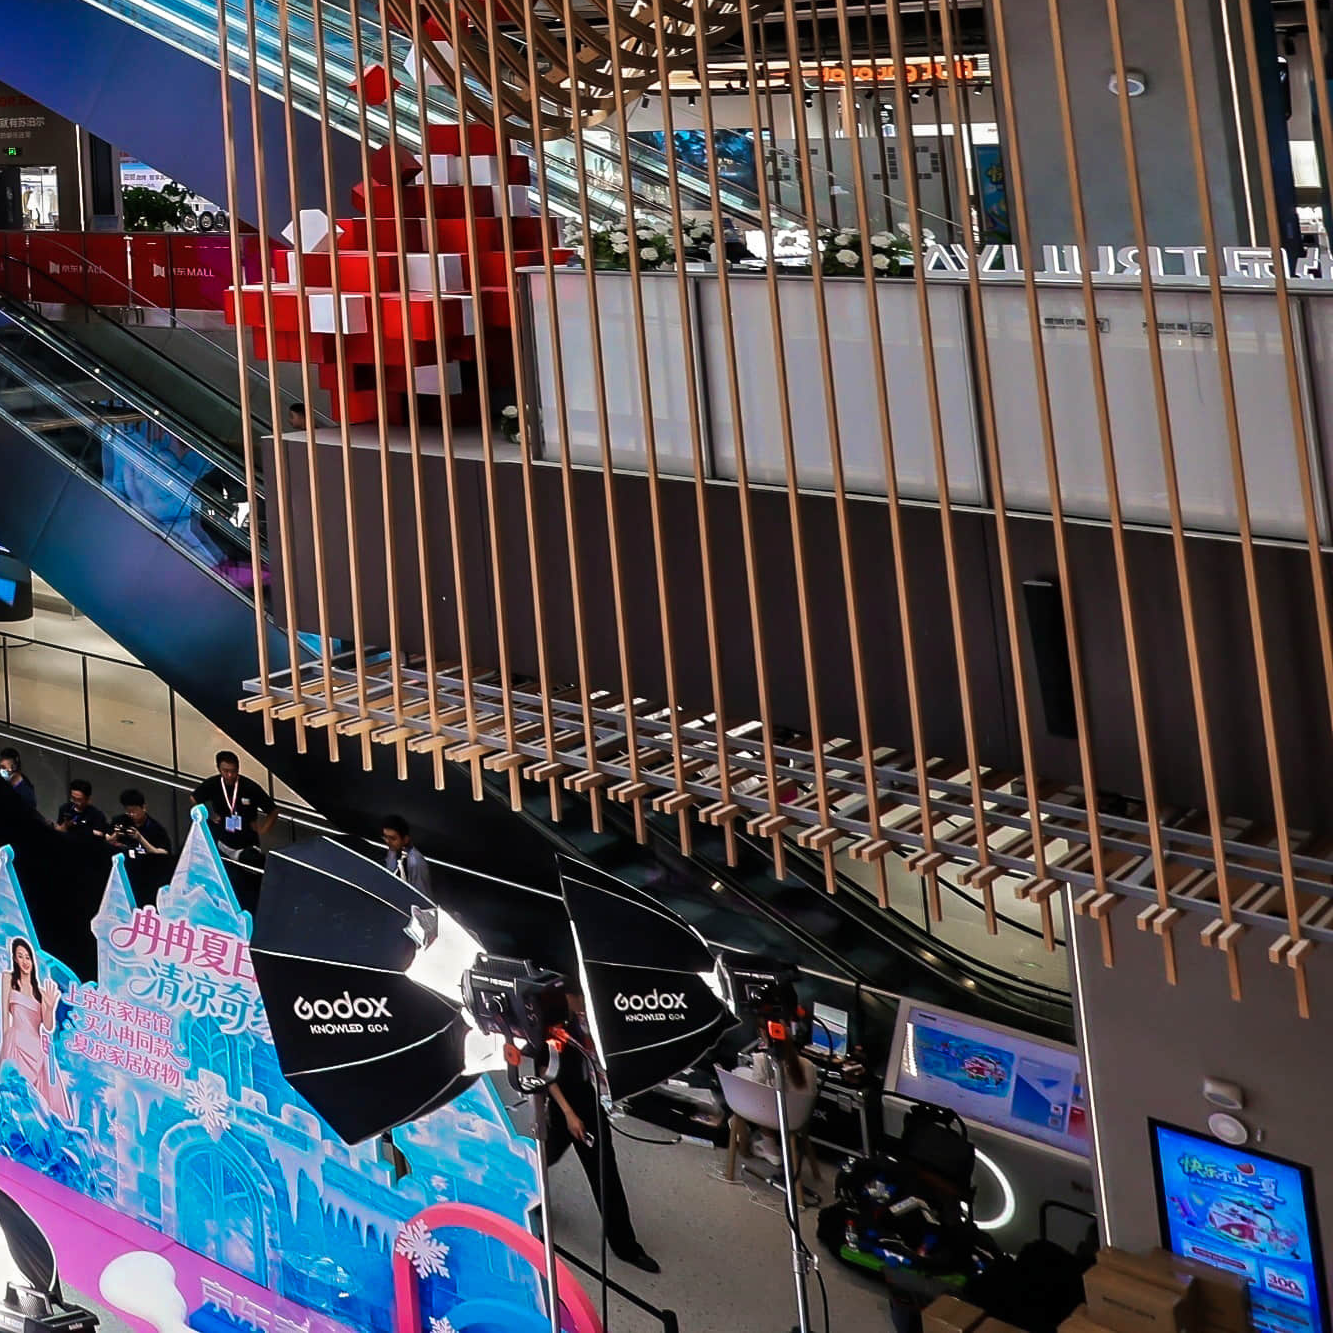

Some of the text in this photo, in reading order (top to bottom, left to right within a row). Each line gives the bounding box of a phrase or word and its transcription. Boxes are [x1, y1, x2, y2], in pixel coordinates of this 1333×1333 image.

[64, 984, 172, 1036] 上京东家居馆
[293, 990, 393, 1020] Godox
[613, 989, 688, 1012] Godox
[309, 1022, 364, 1035] KNOWLED
[625, 1013, 666, 1022] KNOWLED
[83, 1013, 190, 1068] 买小冉同款
[65, 1033, 181, 1088] 夏凉家居好物
